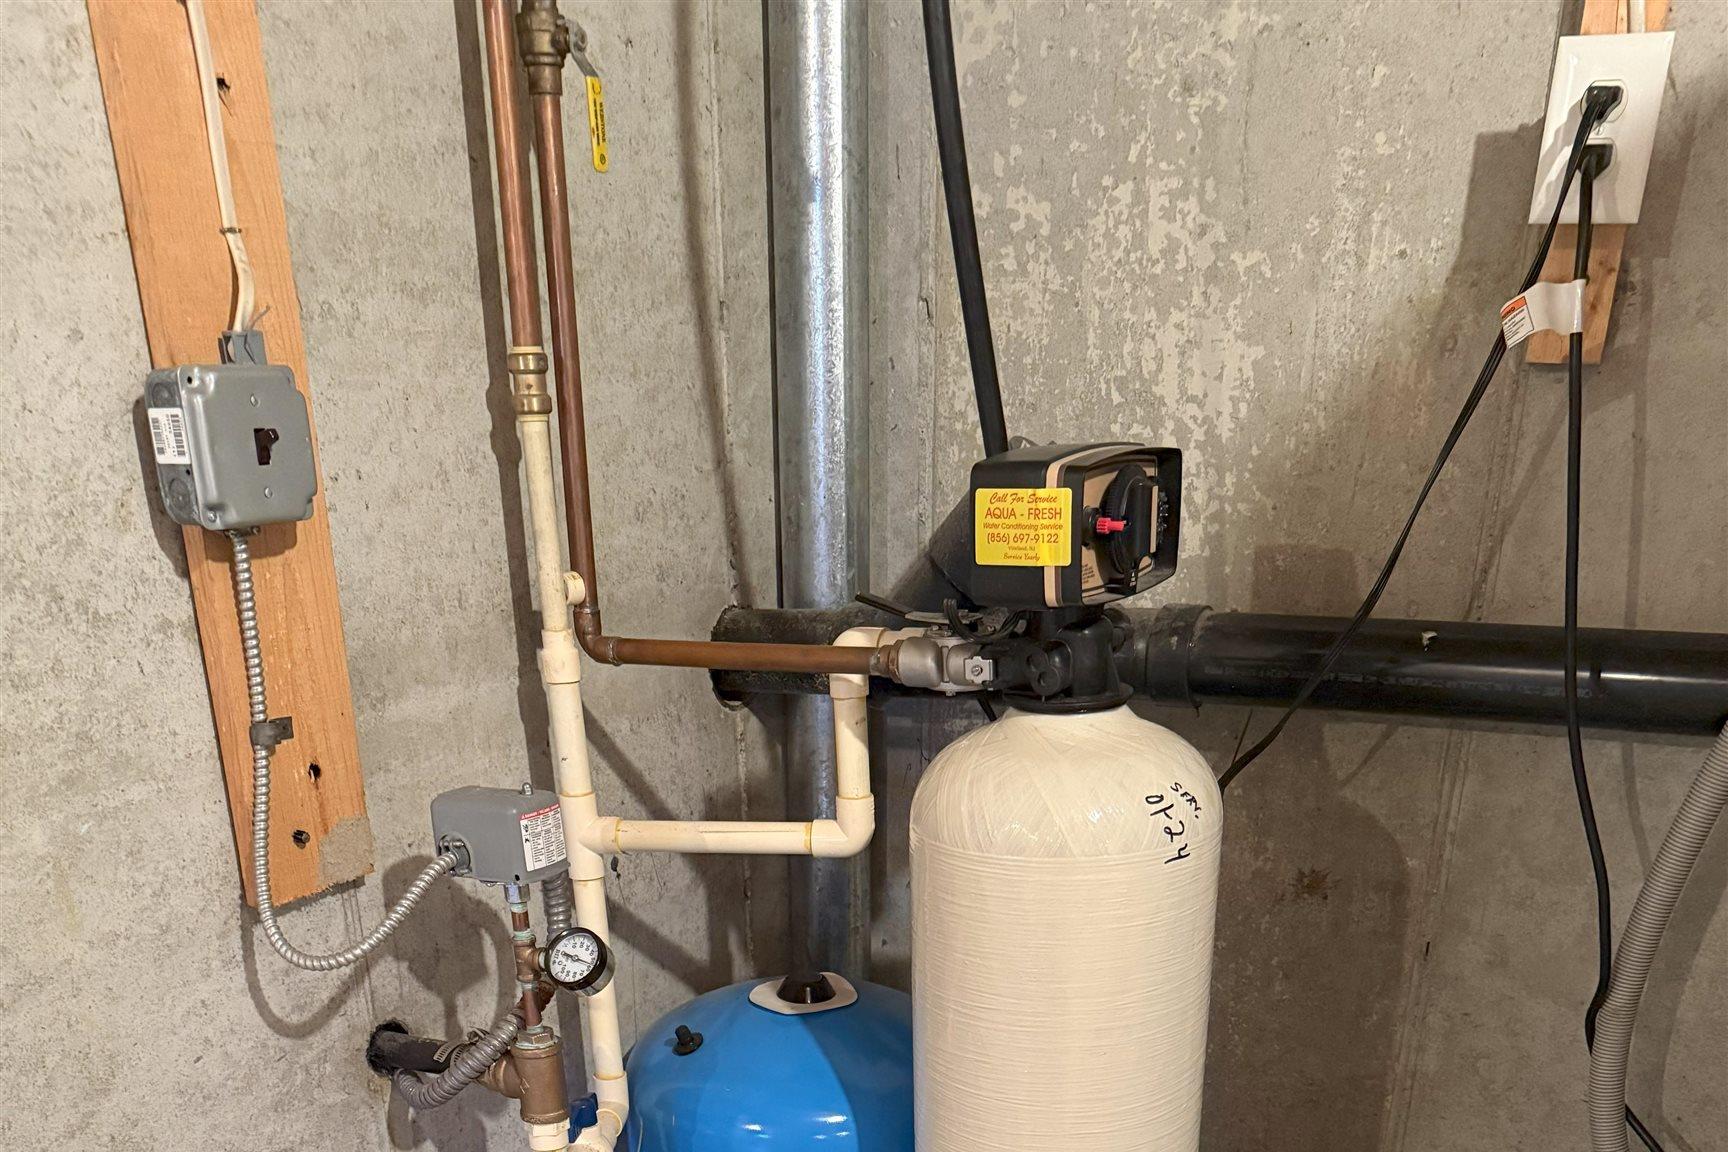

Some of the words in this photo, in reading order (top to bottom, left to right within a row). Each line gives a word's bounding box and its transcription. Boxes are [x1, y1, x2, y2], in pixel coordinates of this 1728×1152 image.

[989, 492, 1009, 504] Call
[1009, 492, 1025, 505] For
[1027, 493, 1058, 504] Service
[984, 507, 1017, 520] AQUA
[1027, 507, 1063, 521] FRESH
[1039, 523, 1064, 531] Service
[987, 532, 1011, 545] (856)
[1012, 533, 1059, 544] 697-9122
